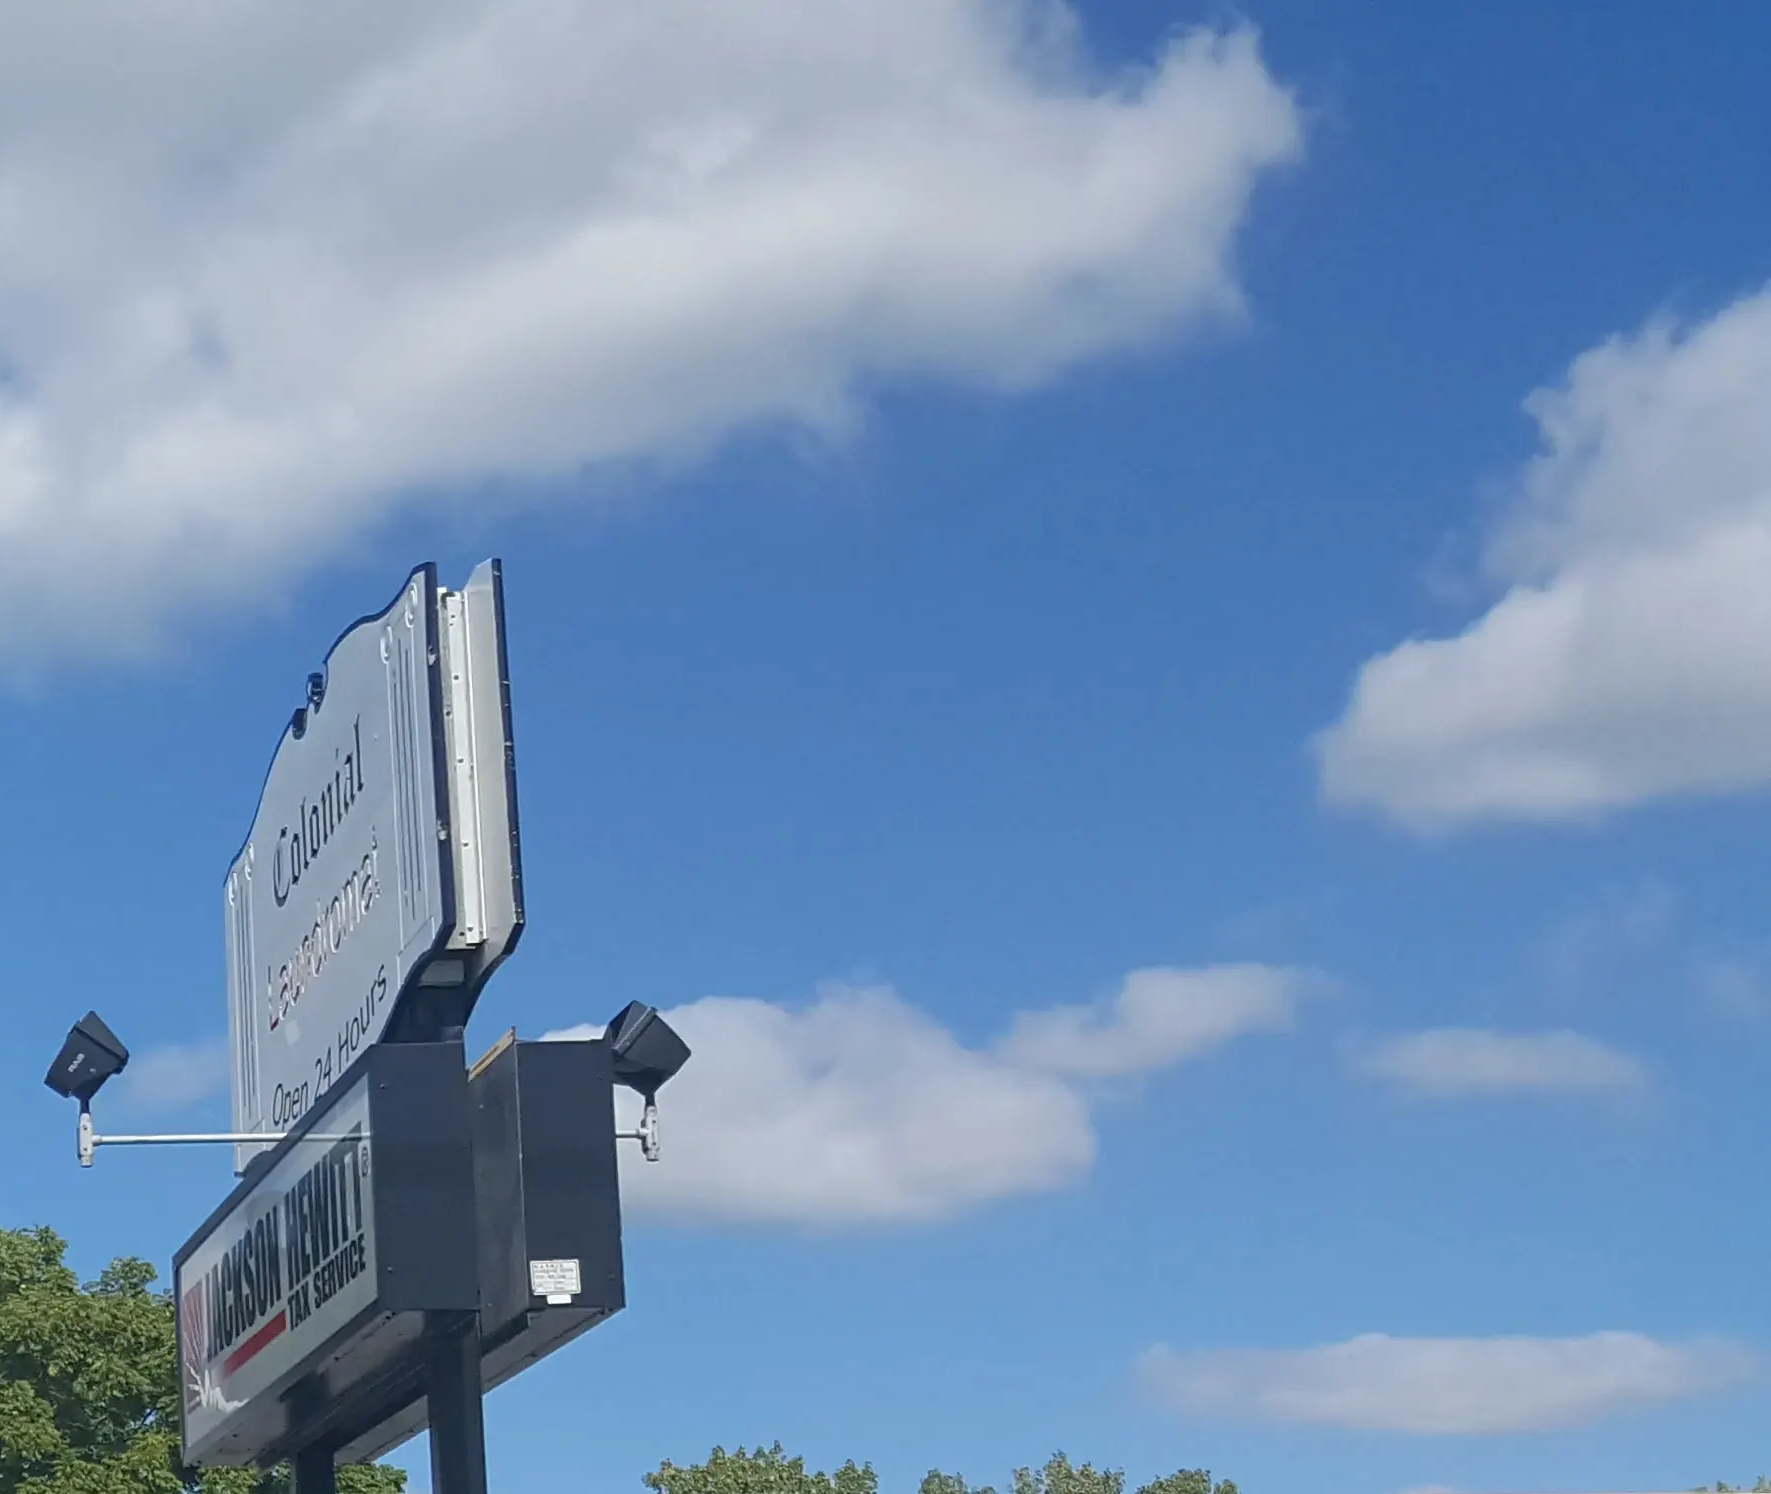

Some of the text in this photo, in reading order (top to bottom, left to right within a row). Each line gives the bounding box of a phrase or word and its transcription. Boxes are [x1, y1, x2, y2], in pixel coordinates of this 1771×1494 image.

[272, 714, 364, 908] Colonial
[272, 964, 387, 1133] Open 24 Hours
[205, 1120, 363, 1363] JACKSON HEWITT
[287, 1232, 367, 1332] TAX SERVICE
